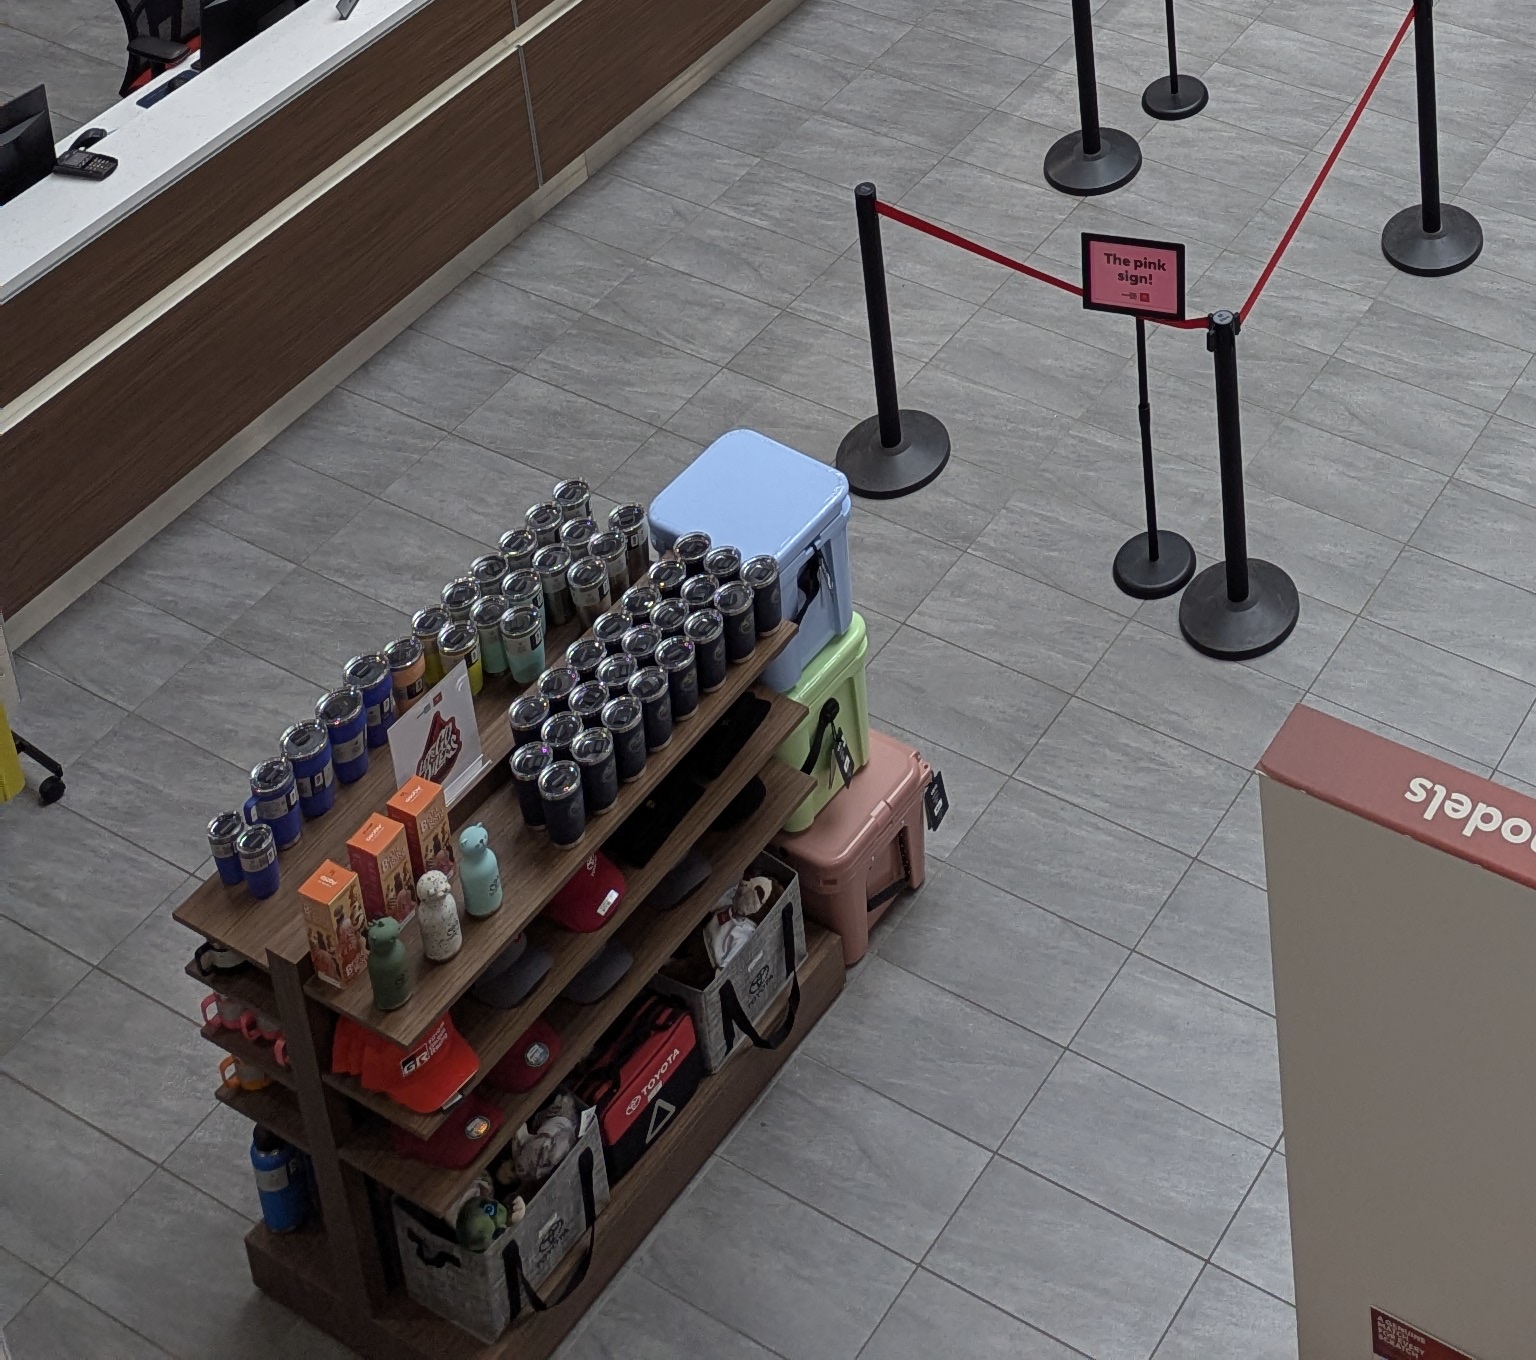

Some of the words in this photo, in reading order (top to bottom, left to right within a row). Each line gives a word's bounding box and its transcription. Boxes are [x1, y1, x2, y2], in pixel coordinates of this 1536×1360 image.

[1103, 253, 1130, 266] The
[1134, 257, 1166, 271] pink
[1117, 270, 1153, 285] sign!
[403, 1051, 430, 1074] GR
[641, 1048, 680, 1095] TOYOTA
[1378, 1322, 1409, 1341] MATCH
[1378, 1327, 1395, 1341] FOR
[1398, 1338, 1425, 1356] EVERY
[1384, 1320, 1426, 1344] GENUINE
